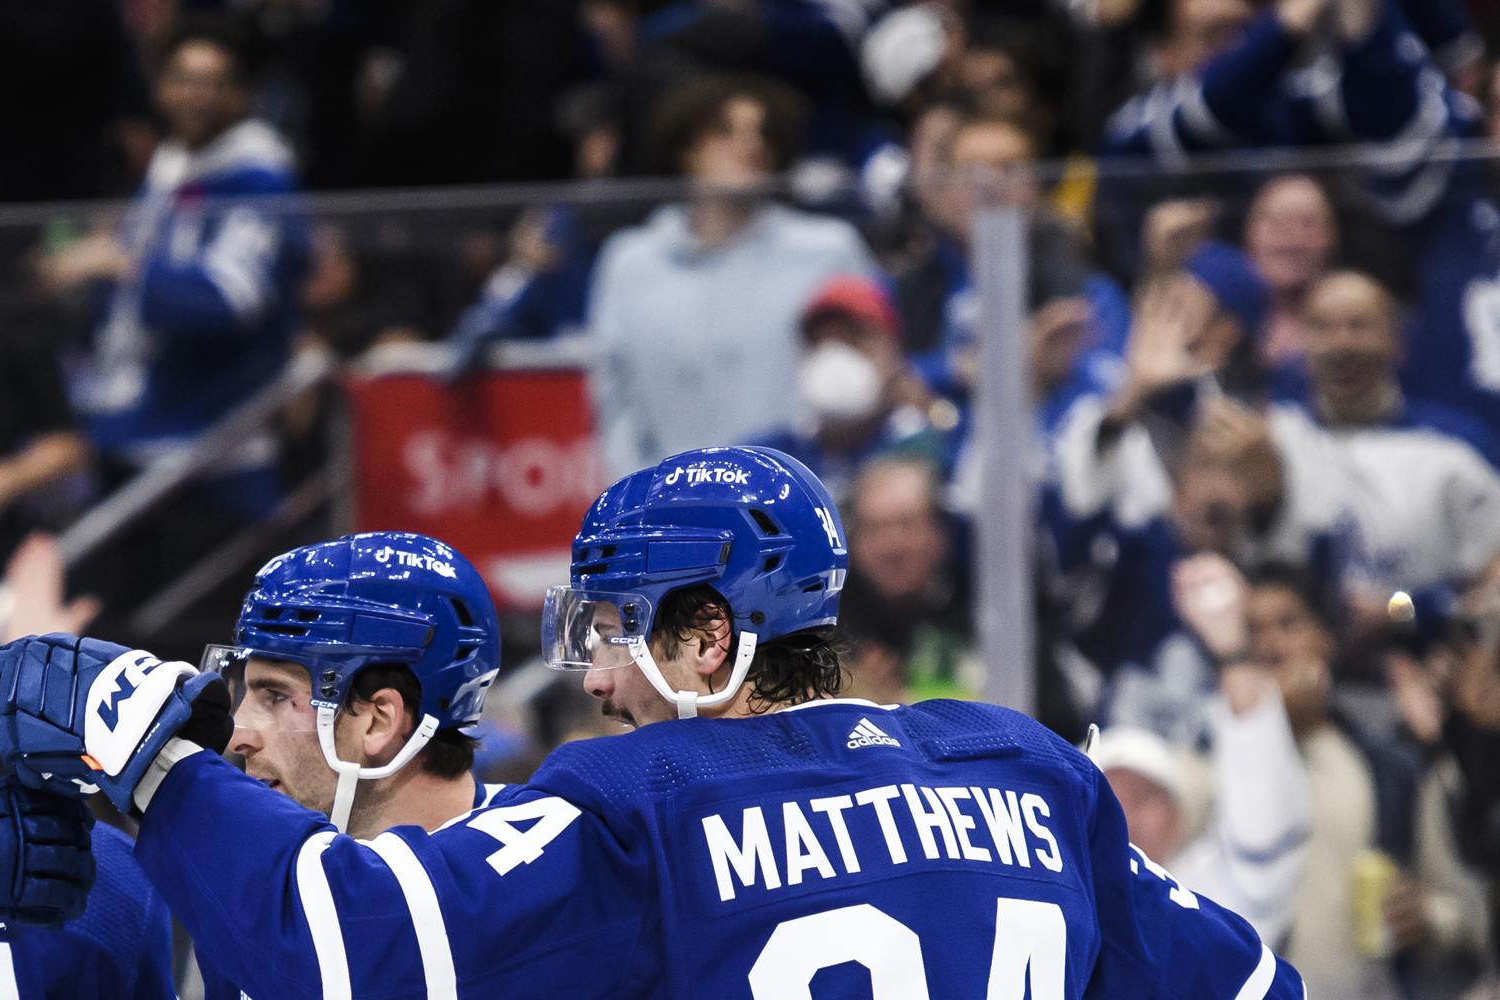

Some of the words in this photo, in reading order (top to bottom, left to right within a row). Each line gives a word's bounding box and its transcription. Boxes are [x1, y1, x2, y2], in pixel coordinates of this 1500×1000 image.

[687, 468, 749, 485] TikTok
[396, 550, 458, 579] TikTok
[701, 783, 1064, 902] MATTHEWS
